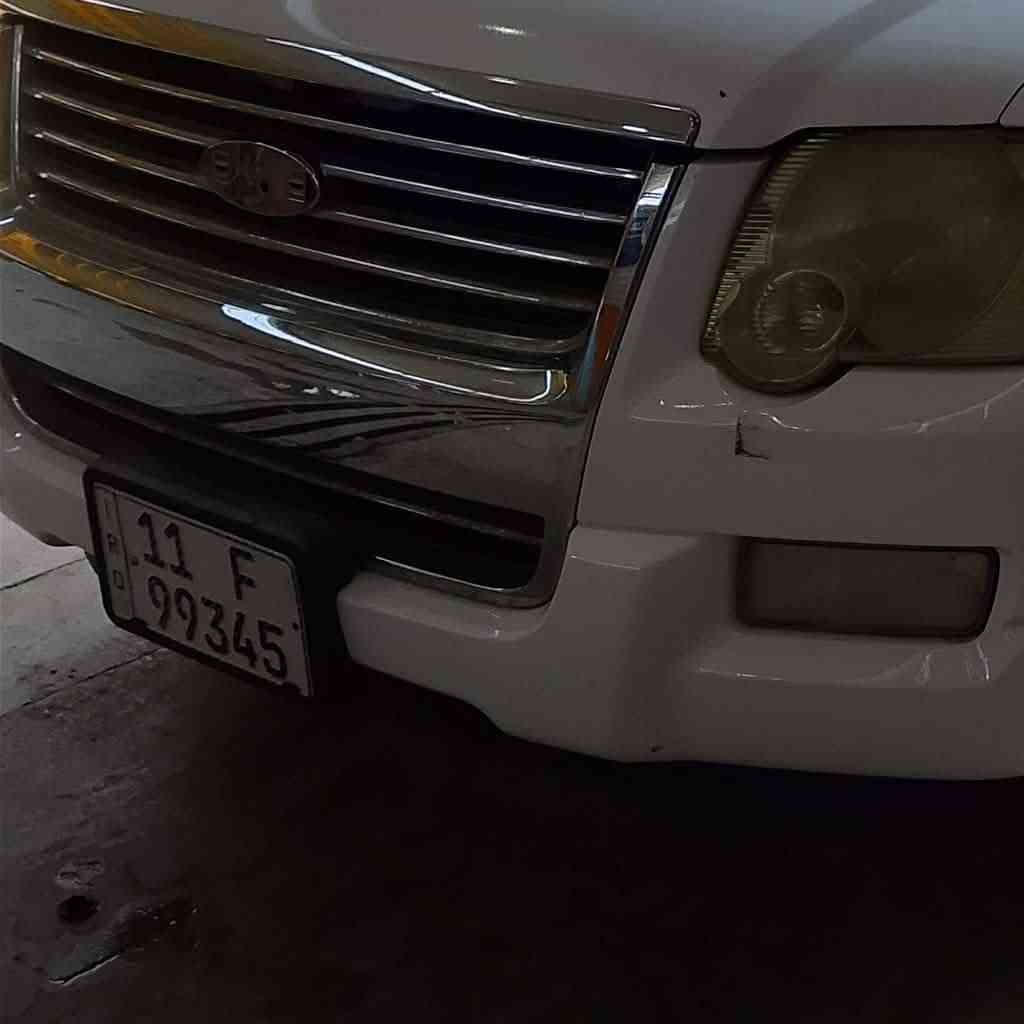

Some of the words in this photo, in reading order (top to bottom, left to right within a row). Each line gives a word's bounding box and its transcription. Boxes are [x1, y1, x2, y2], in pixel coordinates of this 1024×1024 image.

[137, 511, 193, 581] 11
[228, 545, 257, 601] F
[147, 575, 289, 681] 99345
